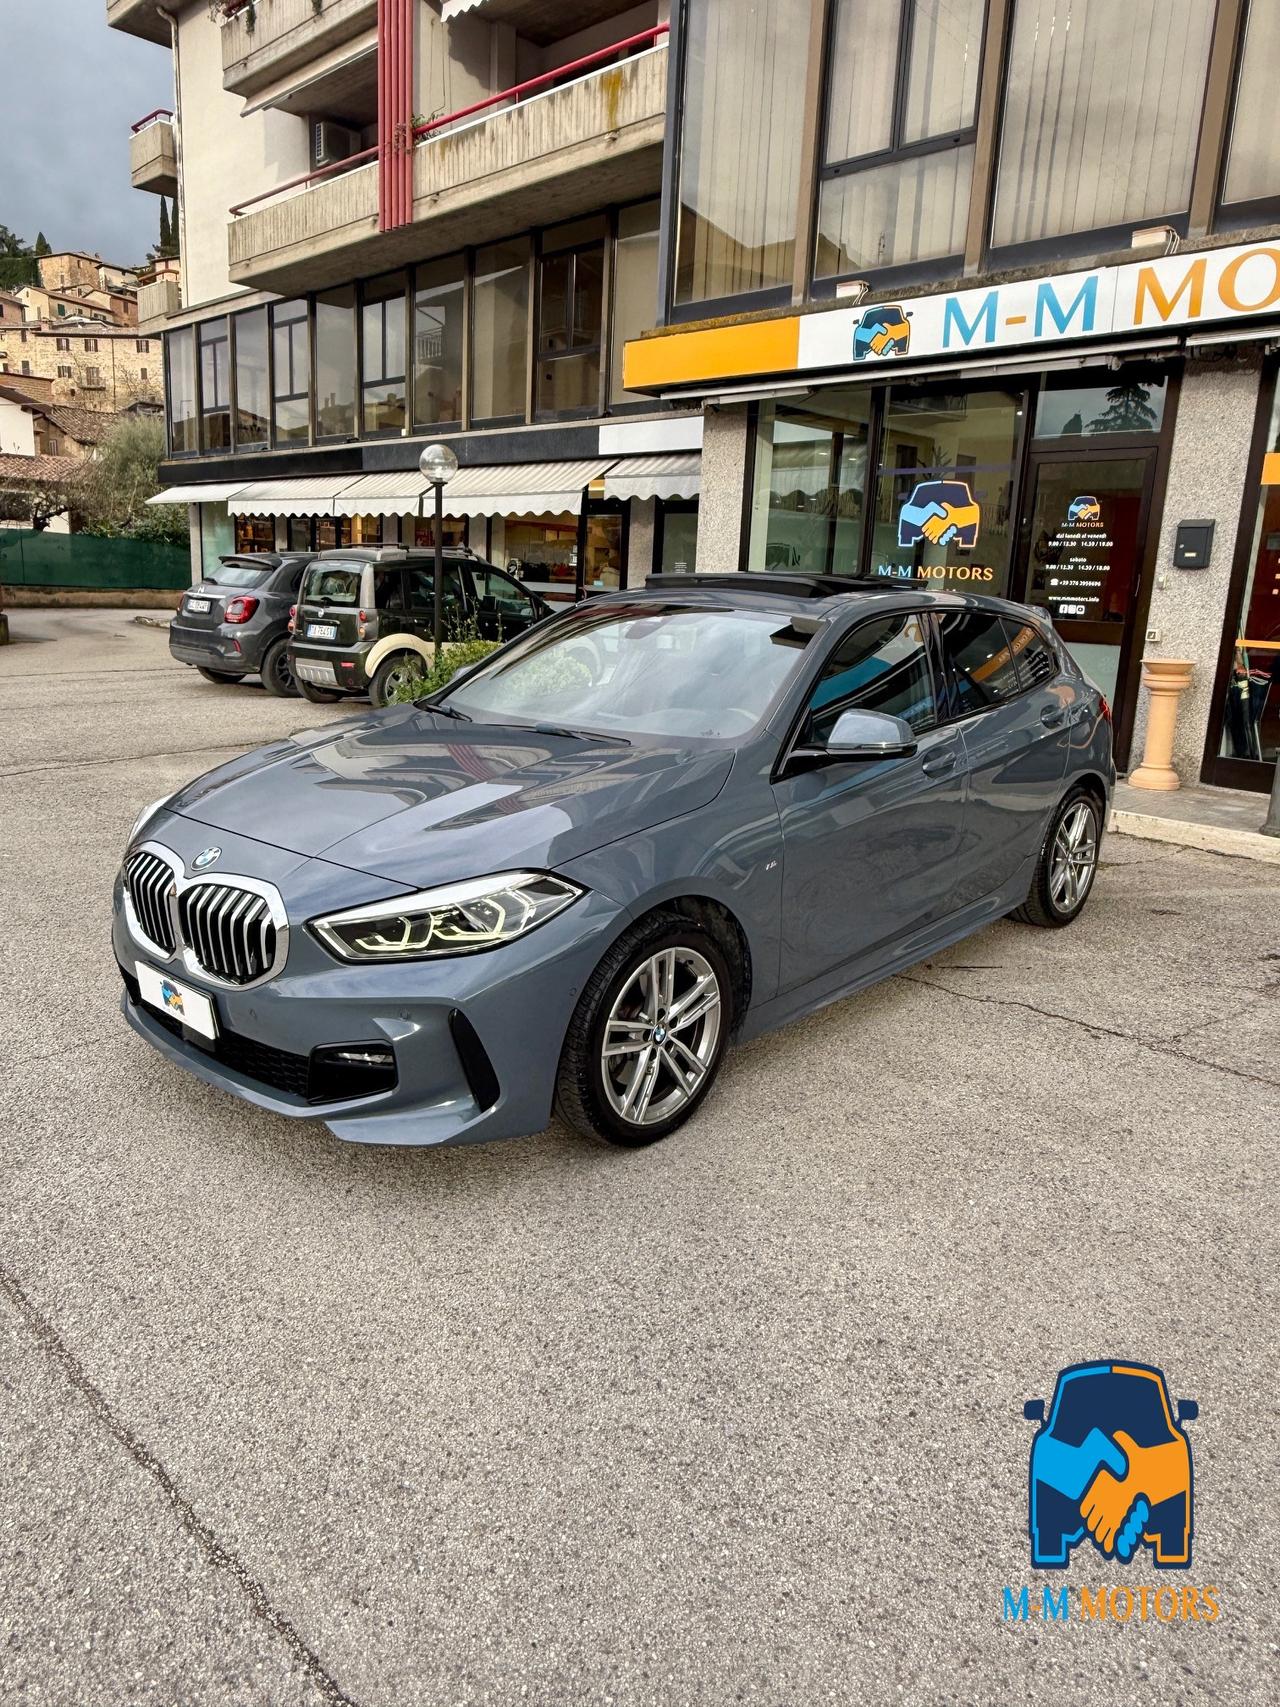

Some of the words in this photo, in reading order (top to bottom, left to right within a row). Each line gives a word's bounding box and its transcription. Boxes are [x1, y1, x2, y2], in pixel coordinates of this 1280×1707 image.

[942, 275, 1099, 348] M-M
[878, 565, 912, 578] M-M
[917, 566, 993, 581] MOTORS
